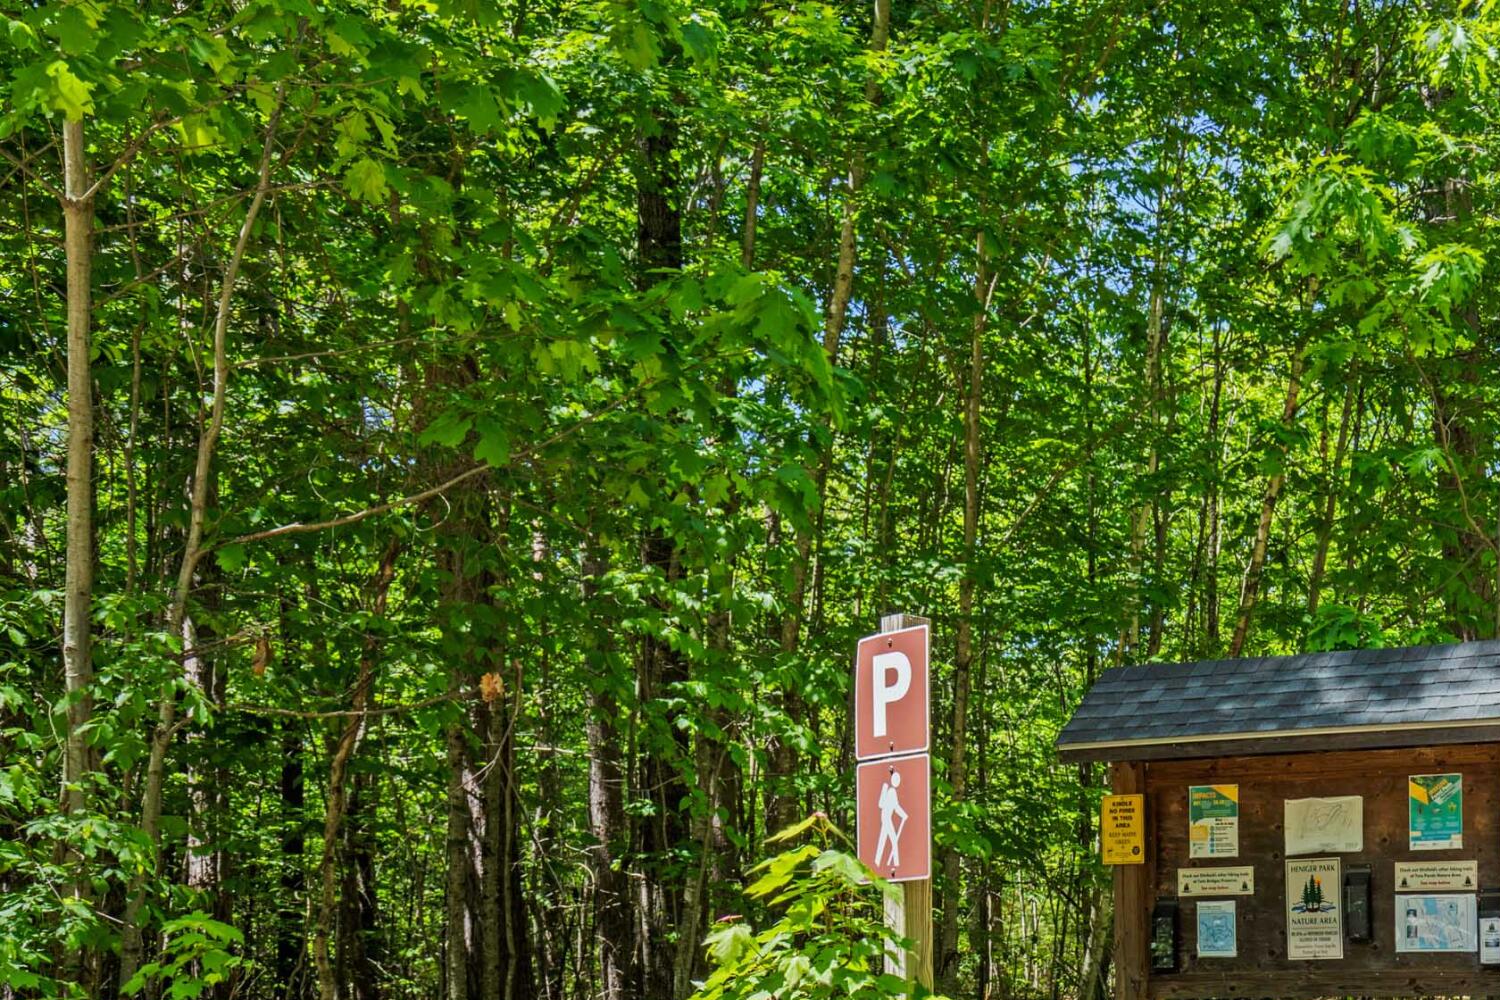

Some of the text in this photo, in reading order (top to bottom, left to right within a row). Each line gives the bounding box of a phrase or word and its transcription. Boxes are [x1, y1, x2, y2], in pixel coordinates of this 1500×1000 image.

[872, 651, 912, 736] P
[1320, 864, 1337, 872] PARK
[1293, 916, 1339, 925] NATURE AREA
